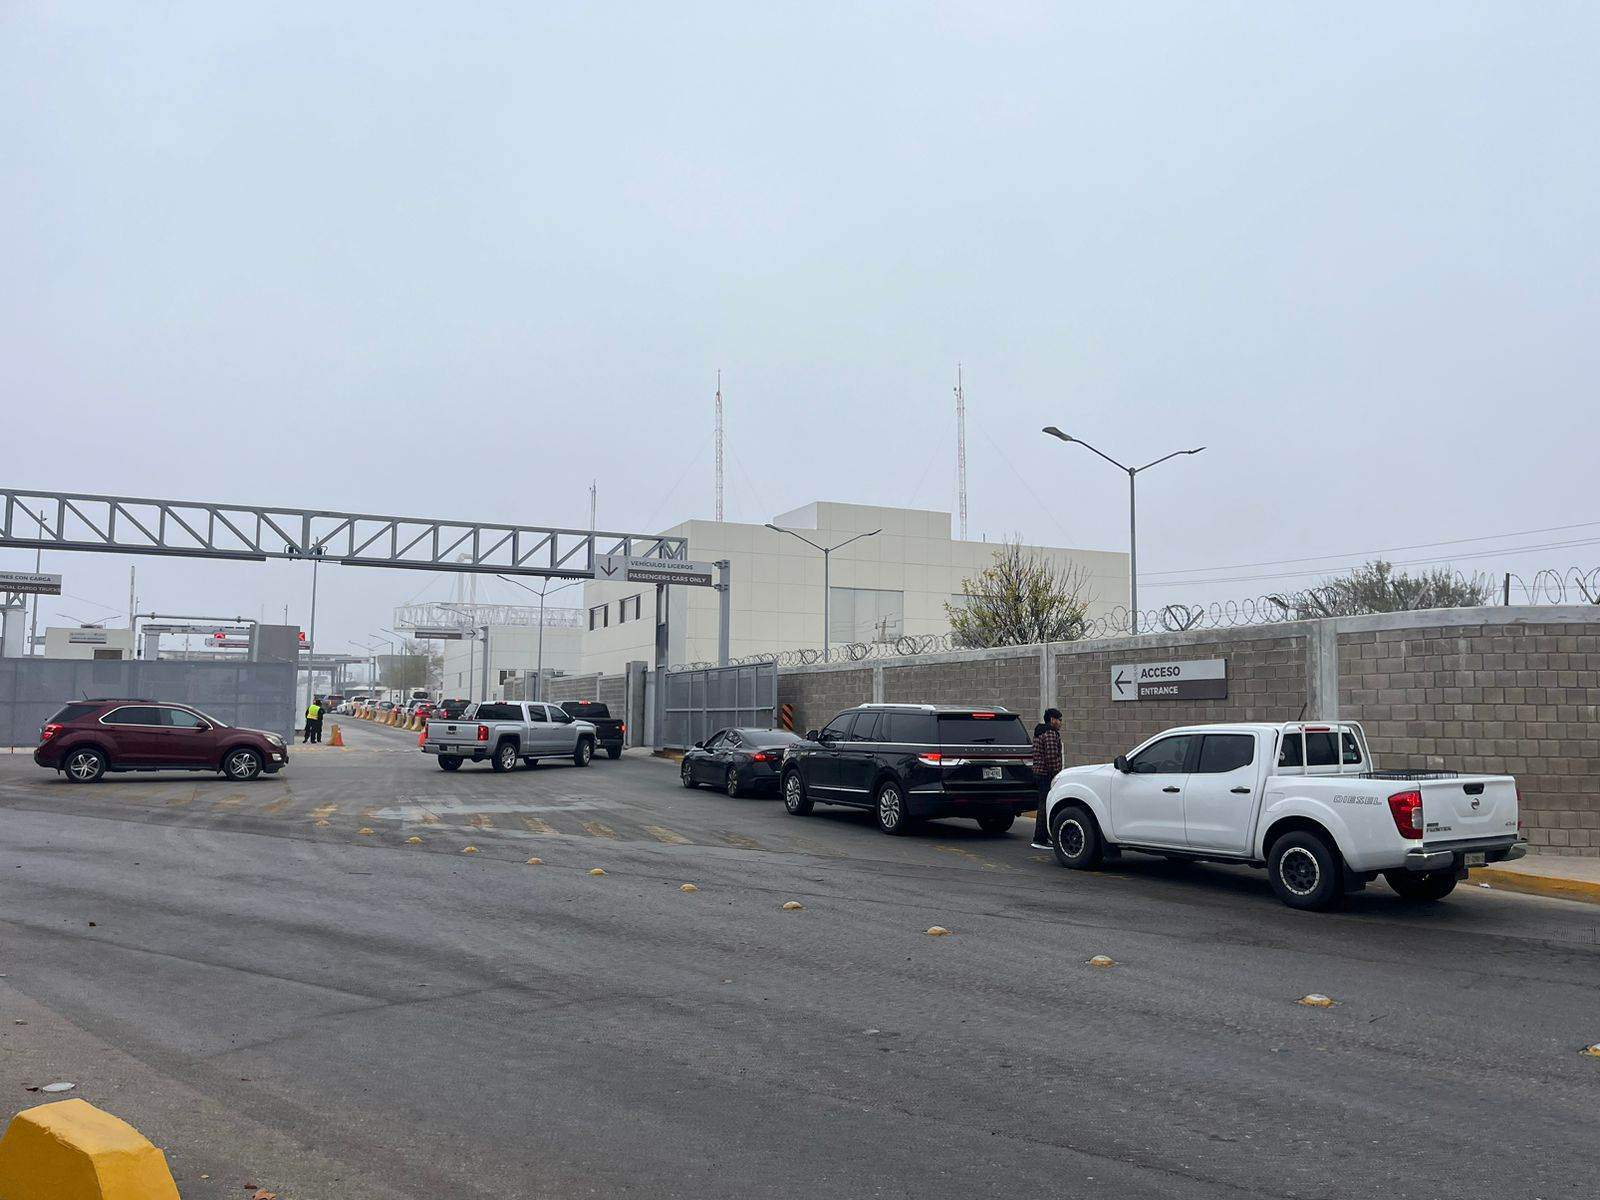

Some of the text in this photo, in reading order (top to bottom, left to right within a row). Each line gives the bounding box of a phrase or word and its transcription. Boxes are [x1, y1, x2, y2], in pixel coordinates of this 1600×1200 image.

[1140, 666, 1180, 678] ACCESO
[1140, 686, 1178, 696] ENTRANCE
[1333, 795, 1382, 805] DIESEL
